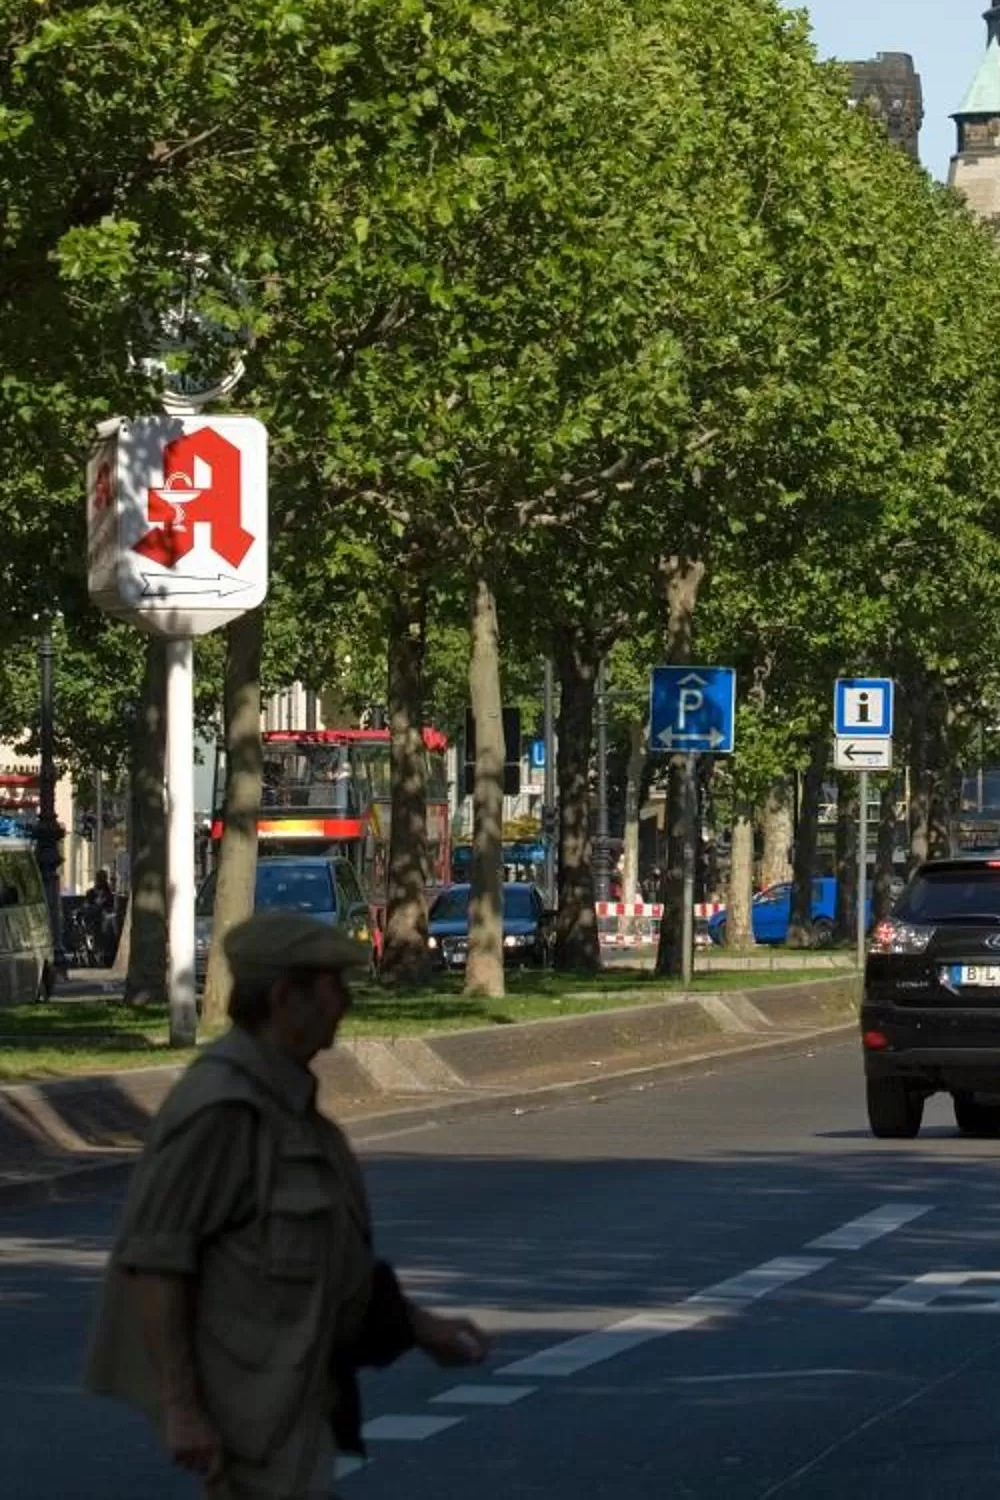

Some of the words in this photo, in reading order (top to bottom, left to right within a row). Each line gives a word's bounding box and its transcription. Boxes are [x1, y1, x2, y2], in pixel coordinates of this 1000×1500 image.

[131, 425, 256, 570] A
[680, 689, 704, 730] P
[966, 966, 977, 981] B
